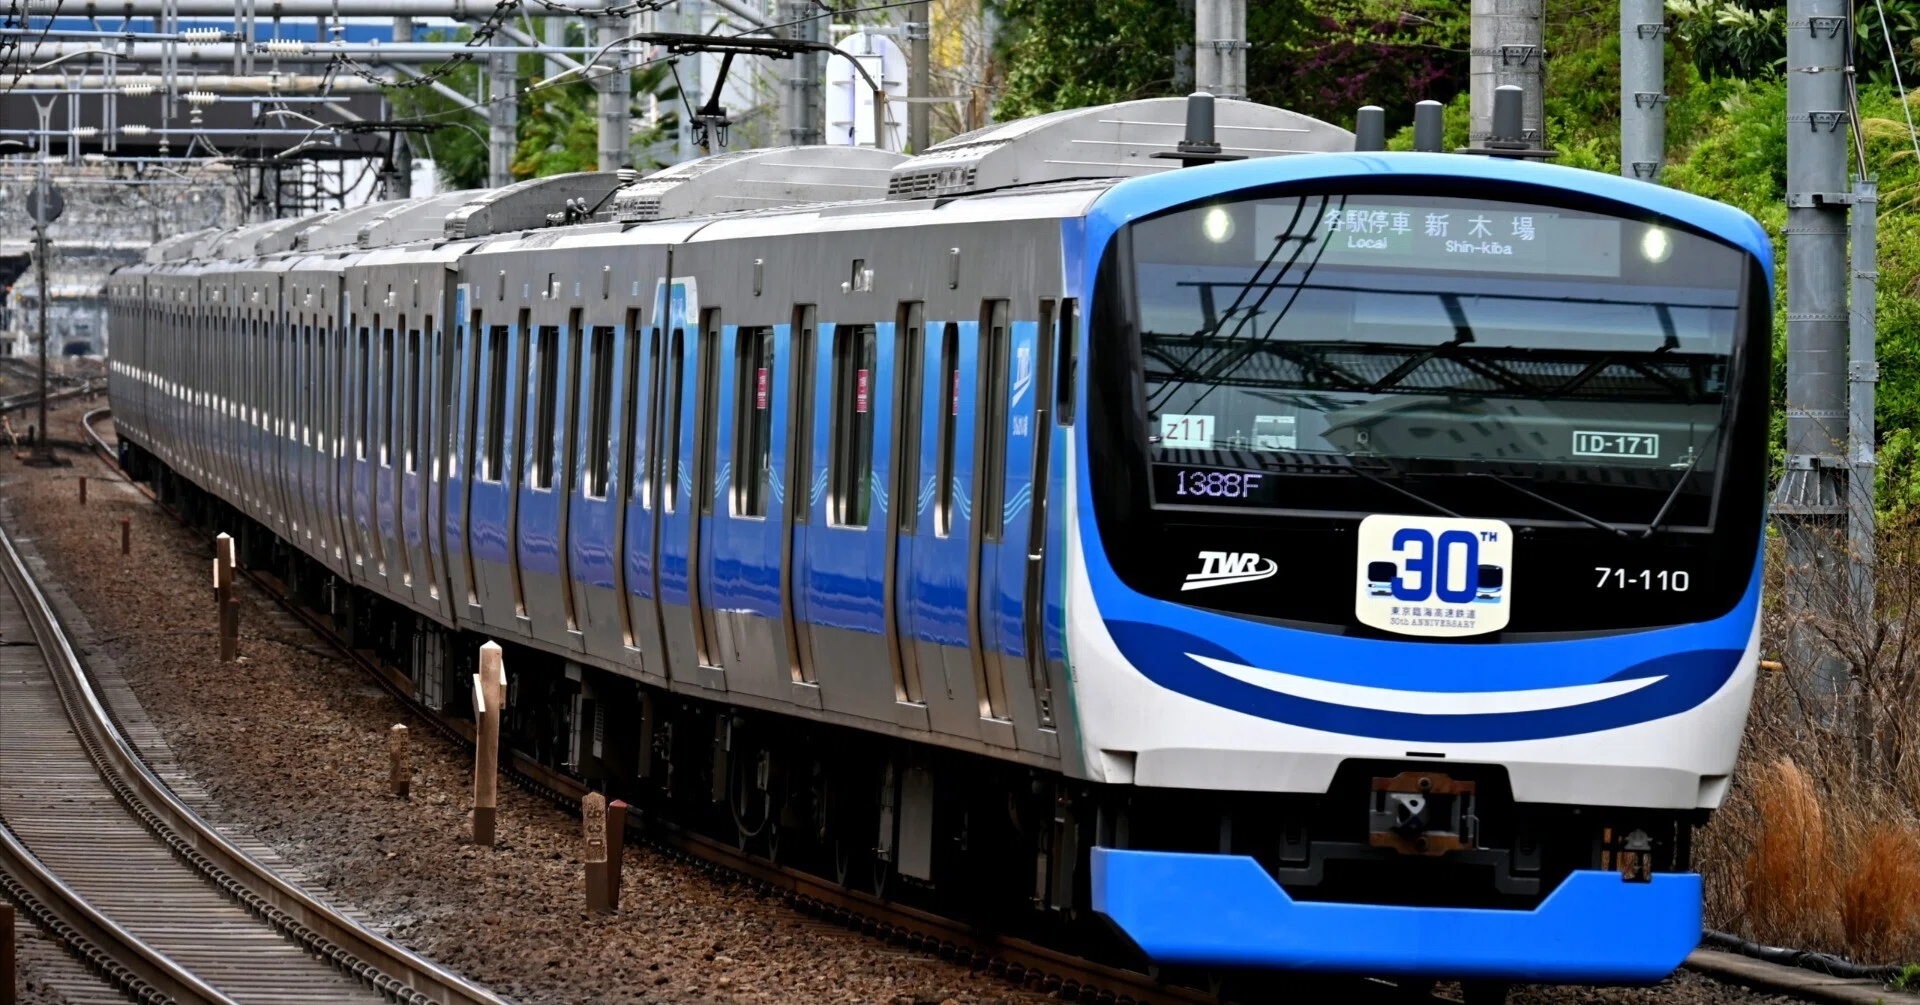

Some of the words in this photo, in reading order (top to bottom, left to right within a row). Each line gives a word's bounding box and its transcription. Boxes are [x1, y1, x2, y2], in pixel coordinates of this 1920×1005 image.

[1324, 208, 1412, 235] 各駅停車
[1424, 212, 1536, 241] 新木場
[1347, 235, 1388, 249] Local
[1445, 240, 1513, 255] Shin-kiba
[1580, 435, 1653, 454] ID-171
[1176, 470, 1263, 498] 1388F
[1594, 567, 1690, 592] 71-110
[1411, 618, 1477, 629] ANNIVERSARY
